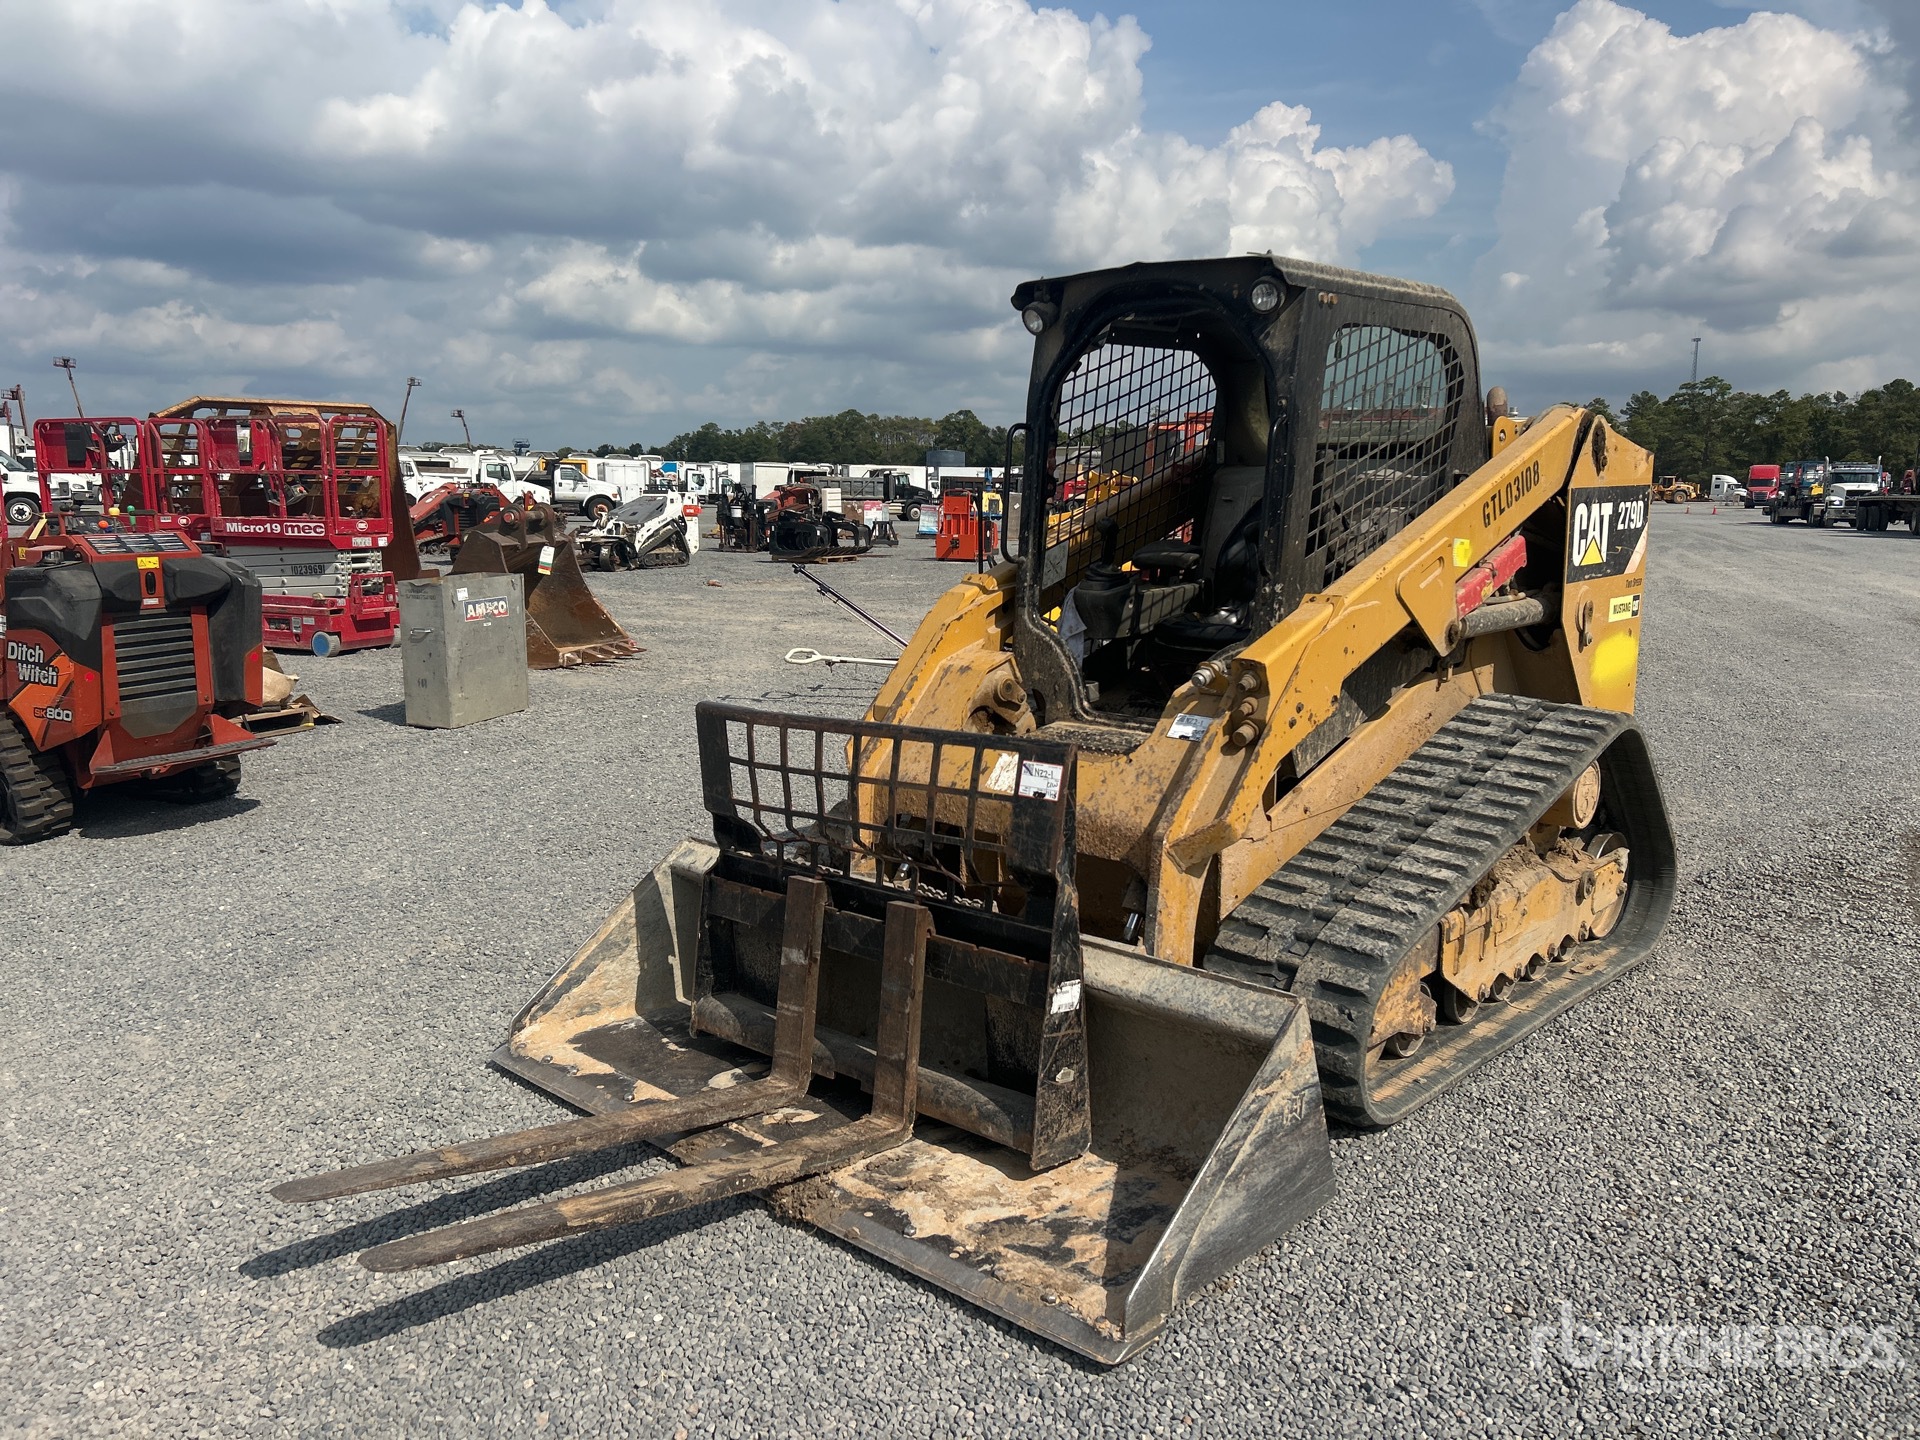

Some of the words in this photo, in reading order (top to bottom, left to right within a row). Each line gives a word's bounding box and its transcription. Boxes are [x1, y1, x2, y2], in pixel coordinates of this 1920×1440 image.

[226, 522, 281, 534] Micro19
[284, 523, 325, 536] mec
[1573, 502, 1613, 566] CAT
[1617, 500, 1644, 530] 279D
[291, 564, 325, 575] 10239691
[1613, 602, 1631, 614] MUSTANG
[7, 641, 44, 663] Ditch
[18, 662, 57, 685] Witch
[34, 707, 73, 722] SK800
